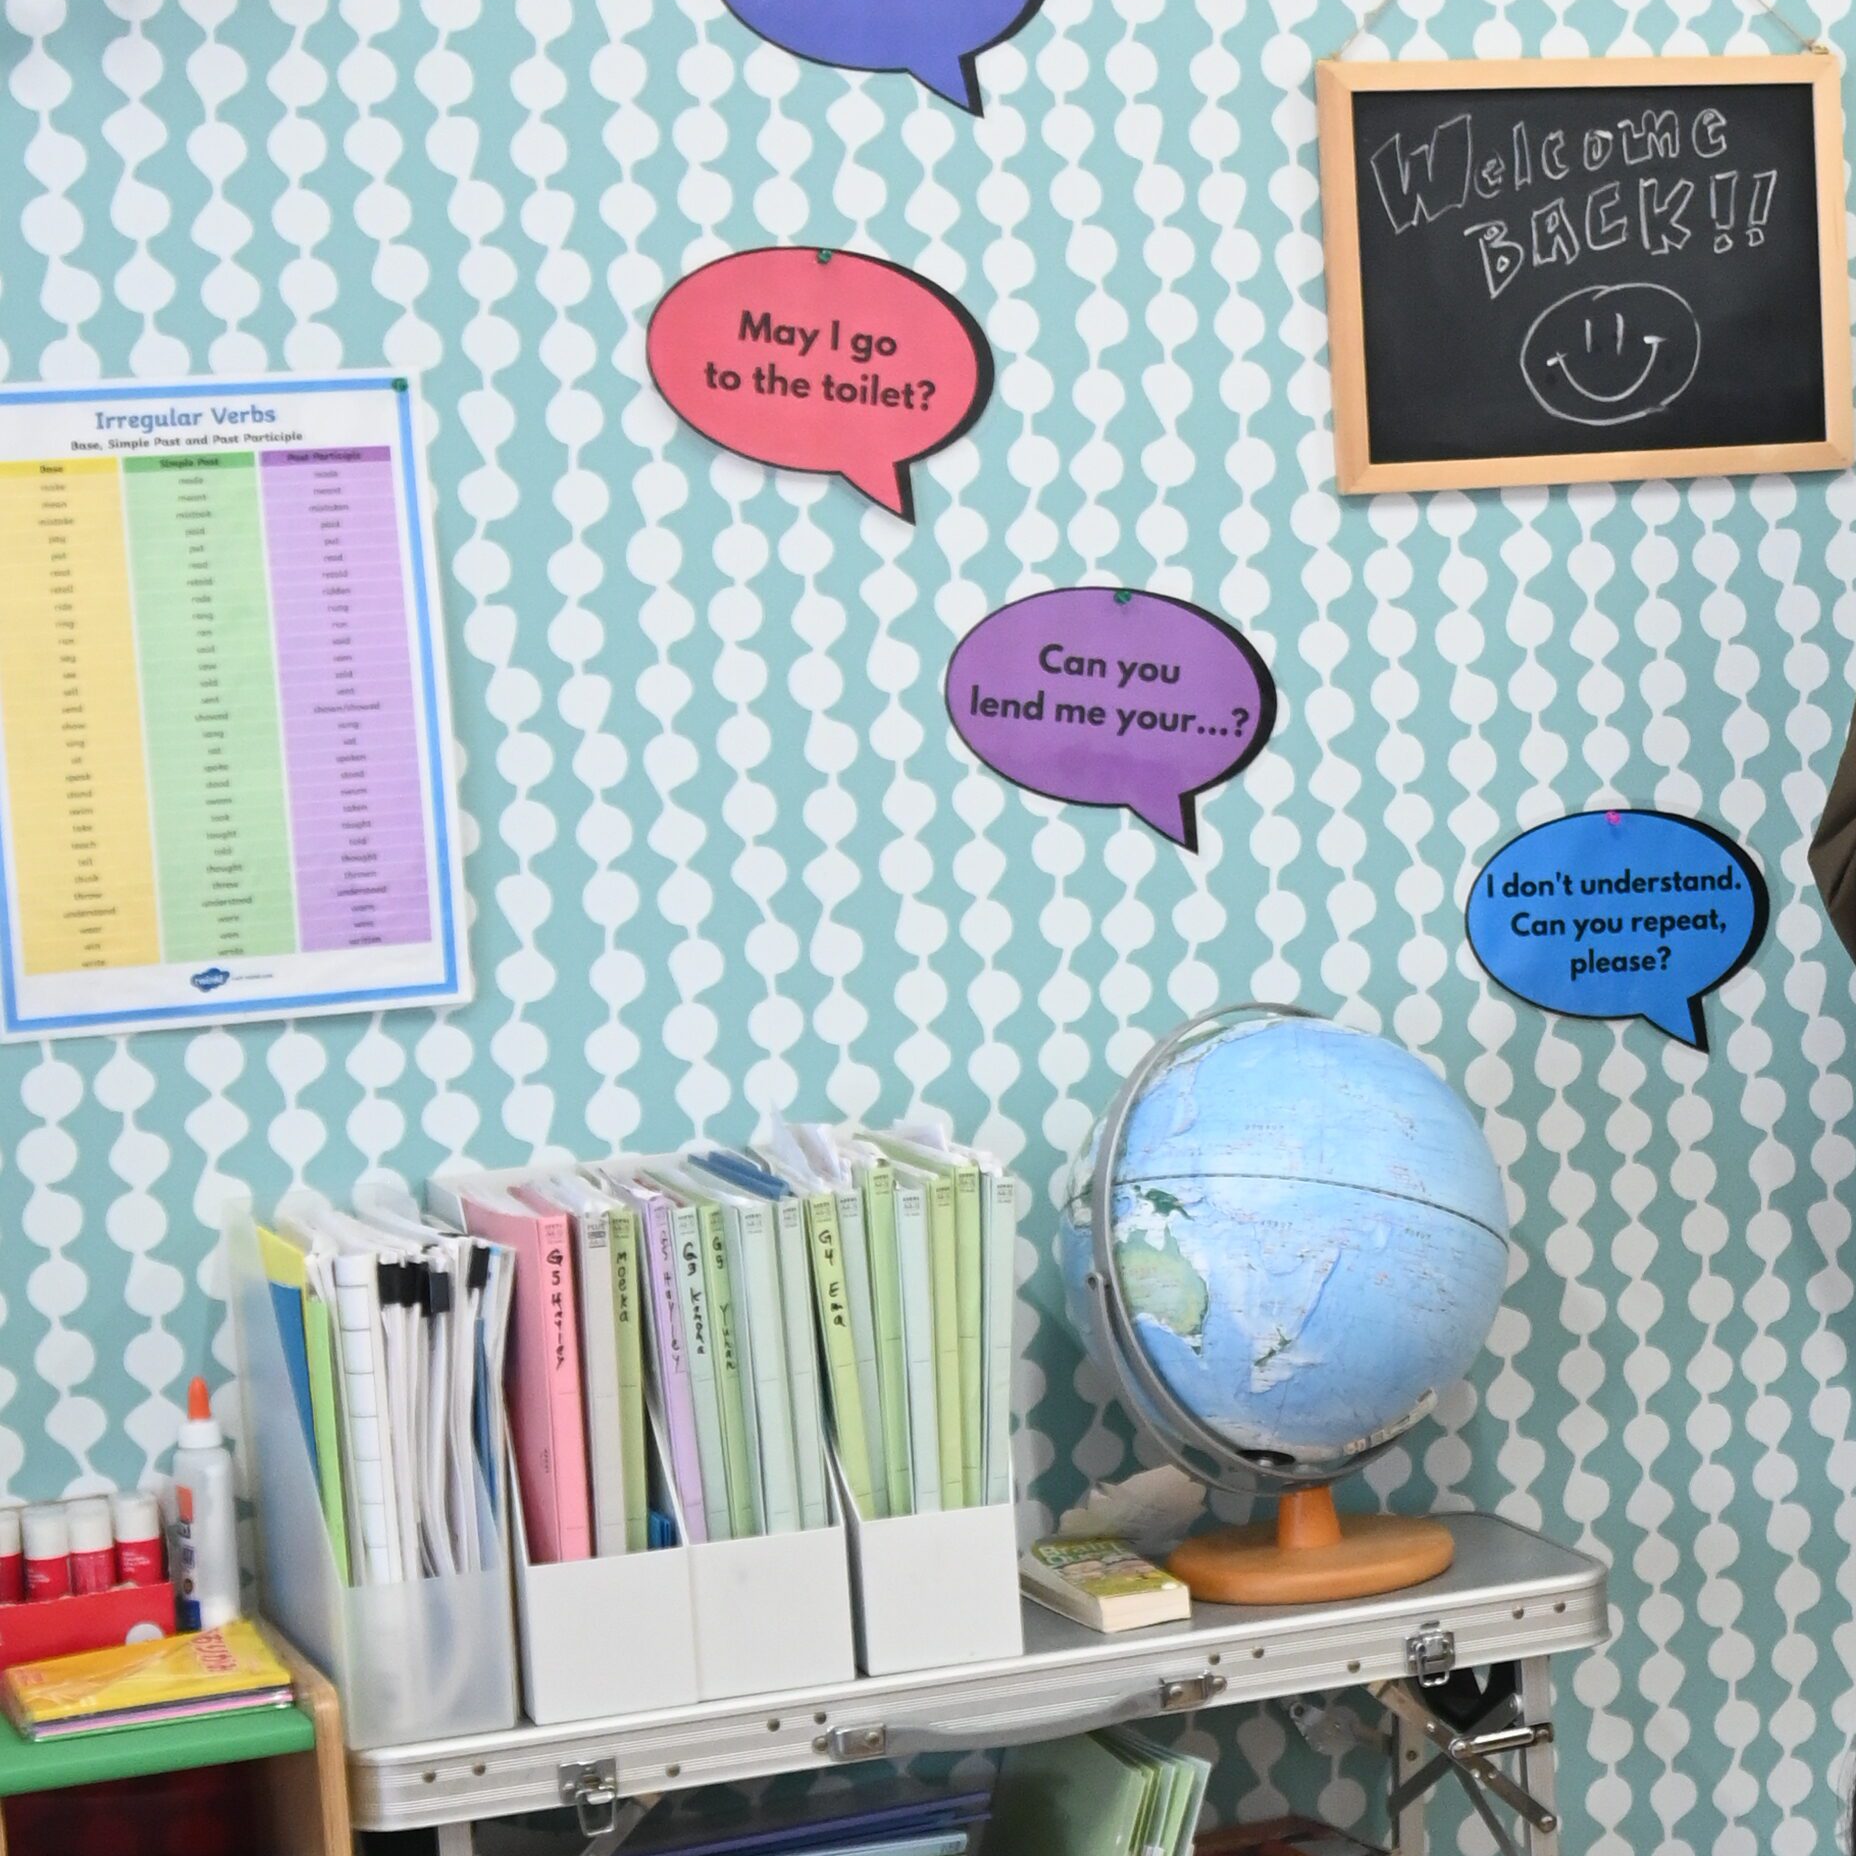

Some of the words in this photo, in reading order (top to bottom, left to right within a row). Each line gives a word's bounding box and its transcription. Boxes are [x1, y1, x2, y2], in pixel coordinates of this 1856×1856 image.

[1370, 107, 1727, 235] Welcome
[1463, 169, 1778, 300] BACK!!
[738, 309, 821, 357] May
[830, 319, 841, 351] I
[850, 333, 898, 364] go
[703, 361, 742, 392] to
[751, 362, 811, 399] the
[821, 373, 936, 412] toilet?
[94, 406, 203, 434] Irregular
[211, 404, 277, 425] Verbs
[70, 441, 104, 452] Base,
[108, 436, 150, 452] Simple
[153, 435, 181, 447] Past
[185, 434, 209, 446] and
[212, 433, 240, 445] Past
[243, 430, 303, 446] Participle
[1038, 643, 1107, 678] Can
[1117, 660, 1181, 689] you
[970, 684, 1045, 721] lend
[1054, 703, 1107, 727] me
[1487, 874, 1494, 898] I
[1502, 871, 1574, 898] don't
[1580, 862, 1743, 896] understand.
[1511, 911, 1566, 937] Can
[1572, 917, 1624, 942] you
[1631, 908, 1727, 939] repeat,
[1570, 945, 1672, 982] please?
